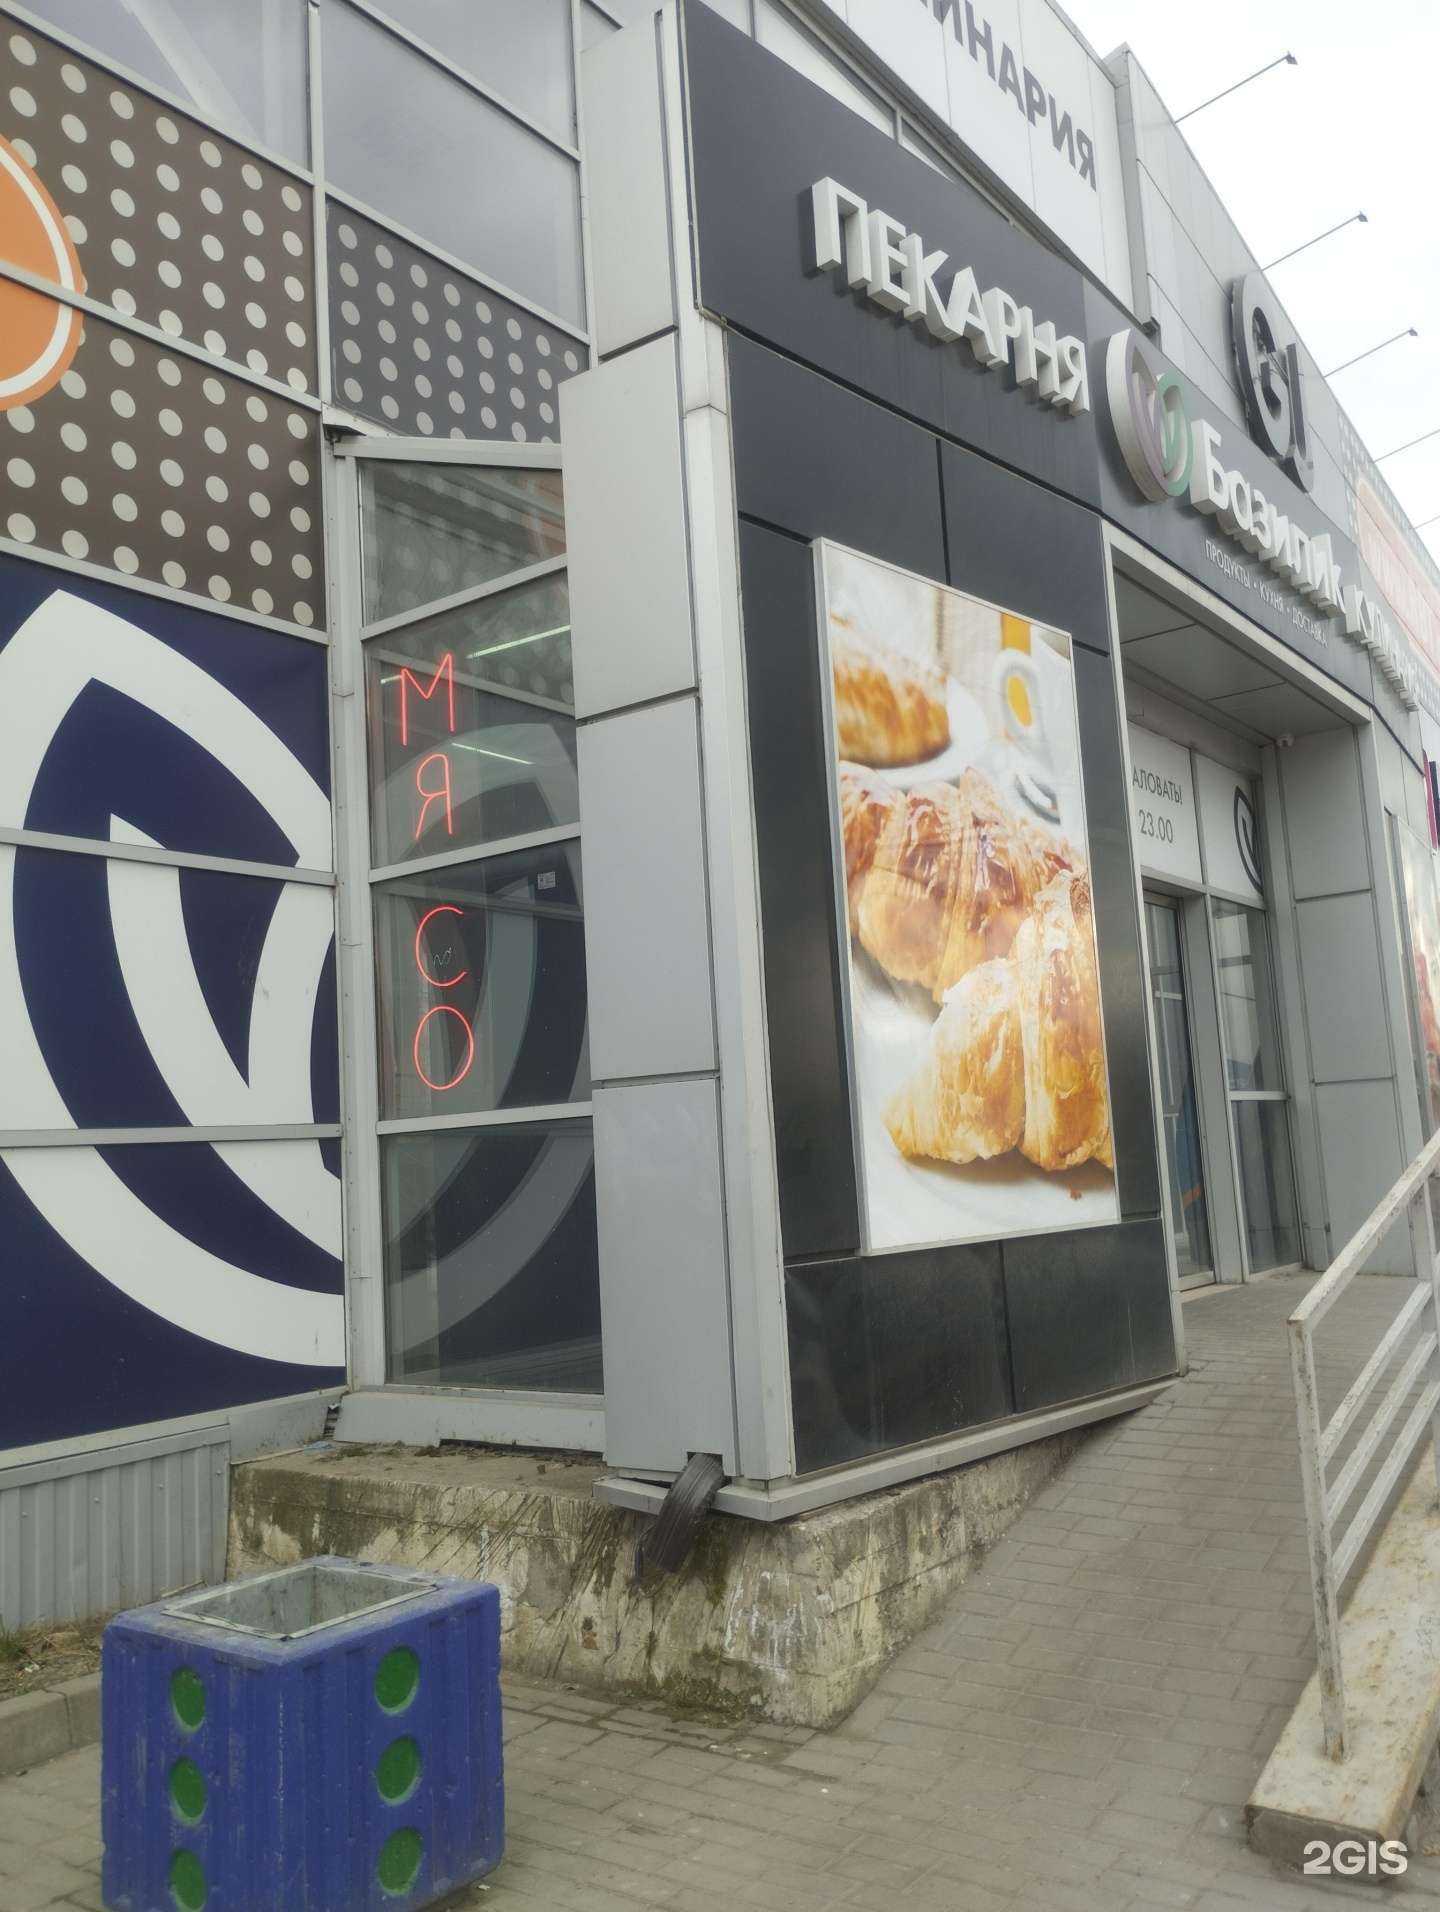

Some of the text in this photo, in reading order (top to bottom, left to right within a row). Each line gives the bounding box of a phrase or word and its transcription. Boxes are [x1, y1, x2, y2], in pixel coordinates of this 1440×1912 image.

[919, 0, 1097, 193] ИНАРИЯ
[811, 176, 1090, 417] ПЕКАРНЯ
[1204, 539, 1251, 590] ПРОДУКТЫ
[1259, 581, 1285, 614] КУХНЯ
[400, 653, 475, 1091] МЯСО
[1138, 809, 1174, 844] 23.00
